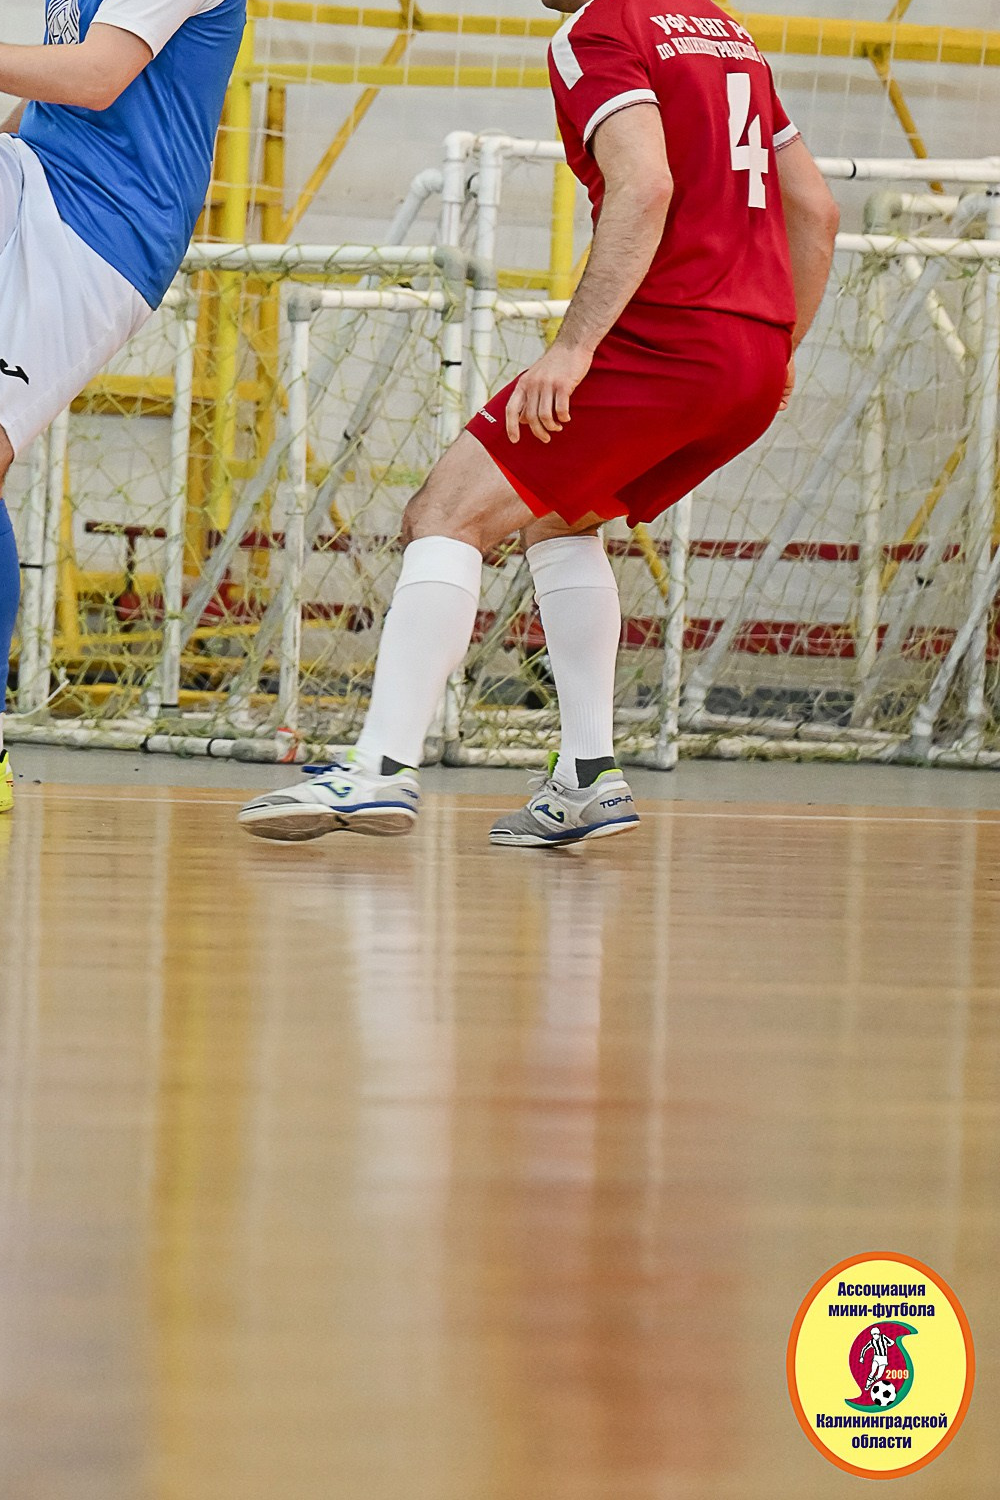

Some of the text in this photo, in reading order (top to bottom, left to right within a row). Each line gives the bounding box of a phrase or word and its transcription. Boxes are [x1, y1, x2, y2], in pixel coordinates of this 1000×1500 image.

[649, 13, 697, 36] УФС
[688, 15, 730, 38] ВНГ
[726, 72, 769, 209] 4
